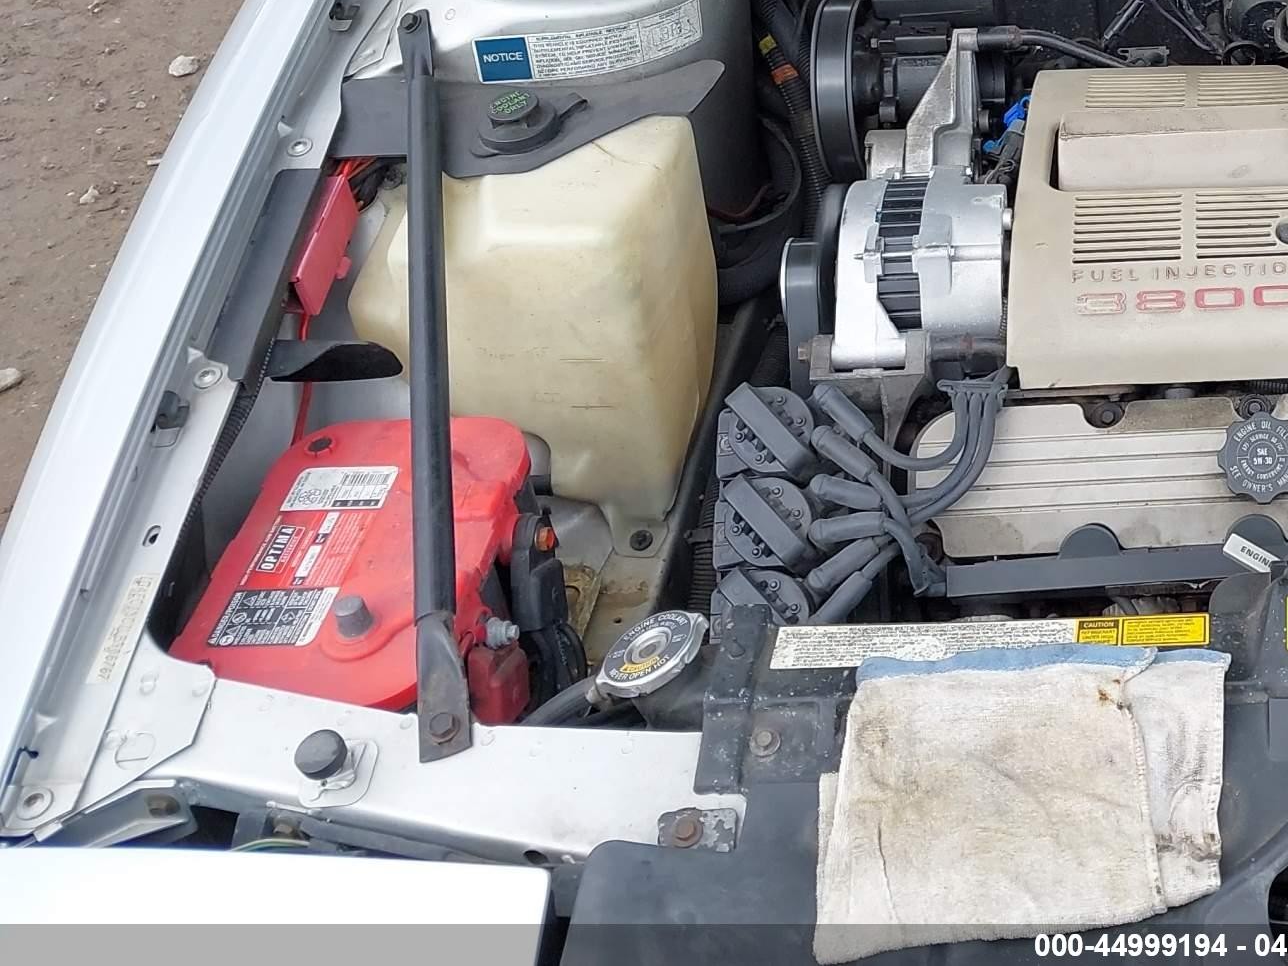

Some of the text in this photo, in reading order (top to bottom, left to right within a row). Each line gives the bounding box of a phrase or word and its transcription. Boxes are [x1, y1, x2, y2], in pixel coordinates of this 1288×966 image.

[482, 51, 524, 64] NOTICE
[1071, 267, 1140, 284] FUEL
[1233, 421, 1288, 442] ENGINE OIL FILL
[1256, 448, 1267, 456] SAE
[1229, 465, 1241, 480] SEE
[1241, 479, 1273, 493] OWNER'S
[261, 527, 296, 570] OPTIMA
[623, 618, 655, 641] ENGINE
[657, 612, 688, 626] COOLANT
[628, 668, 652, 681] OPEN
[653, 655, 671, 670] HOT
